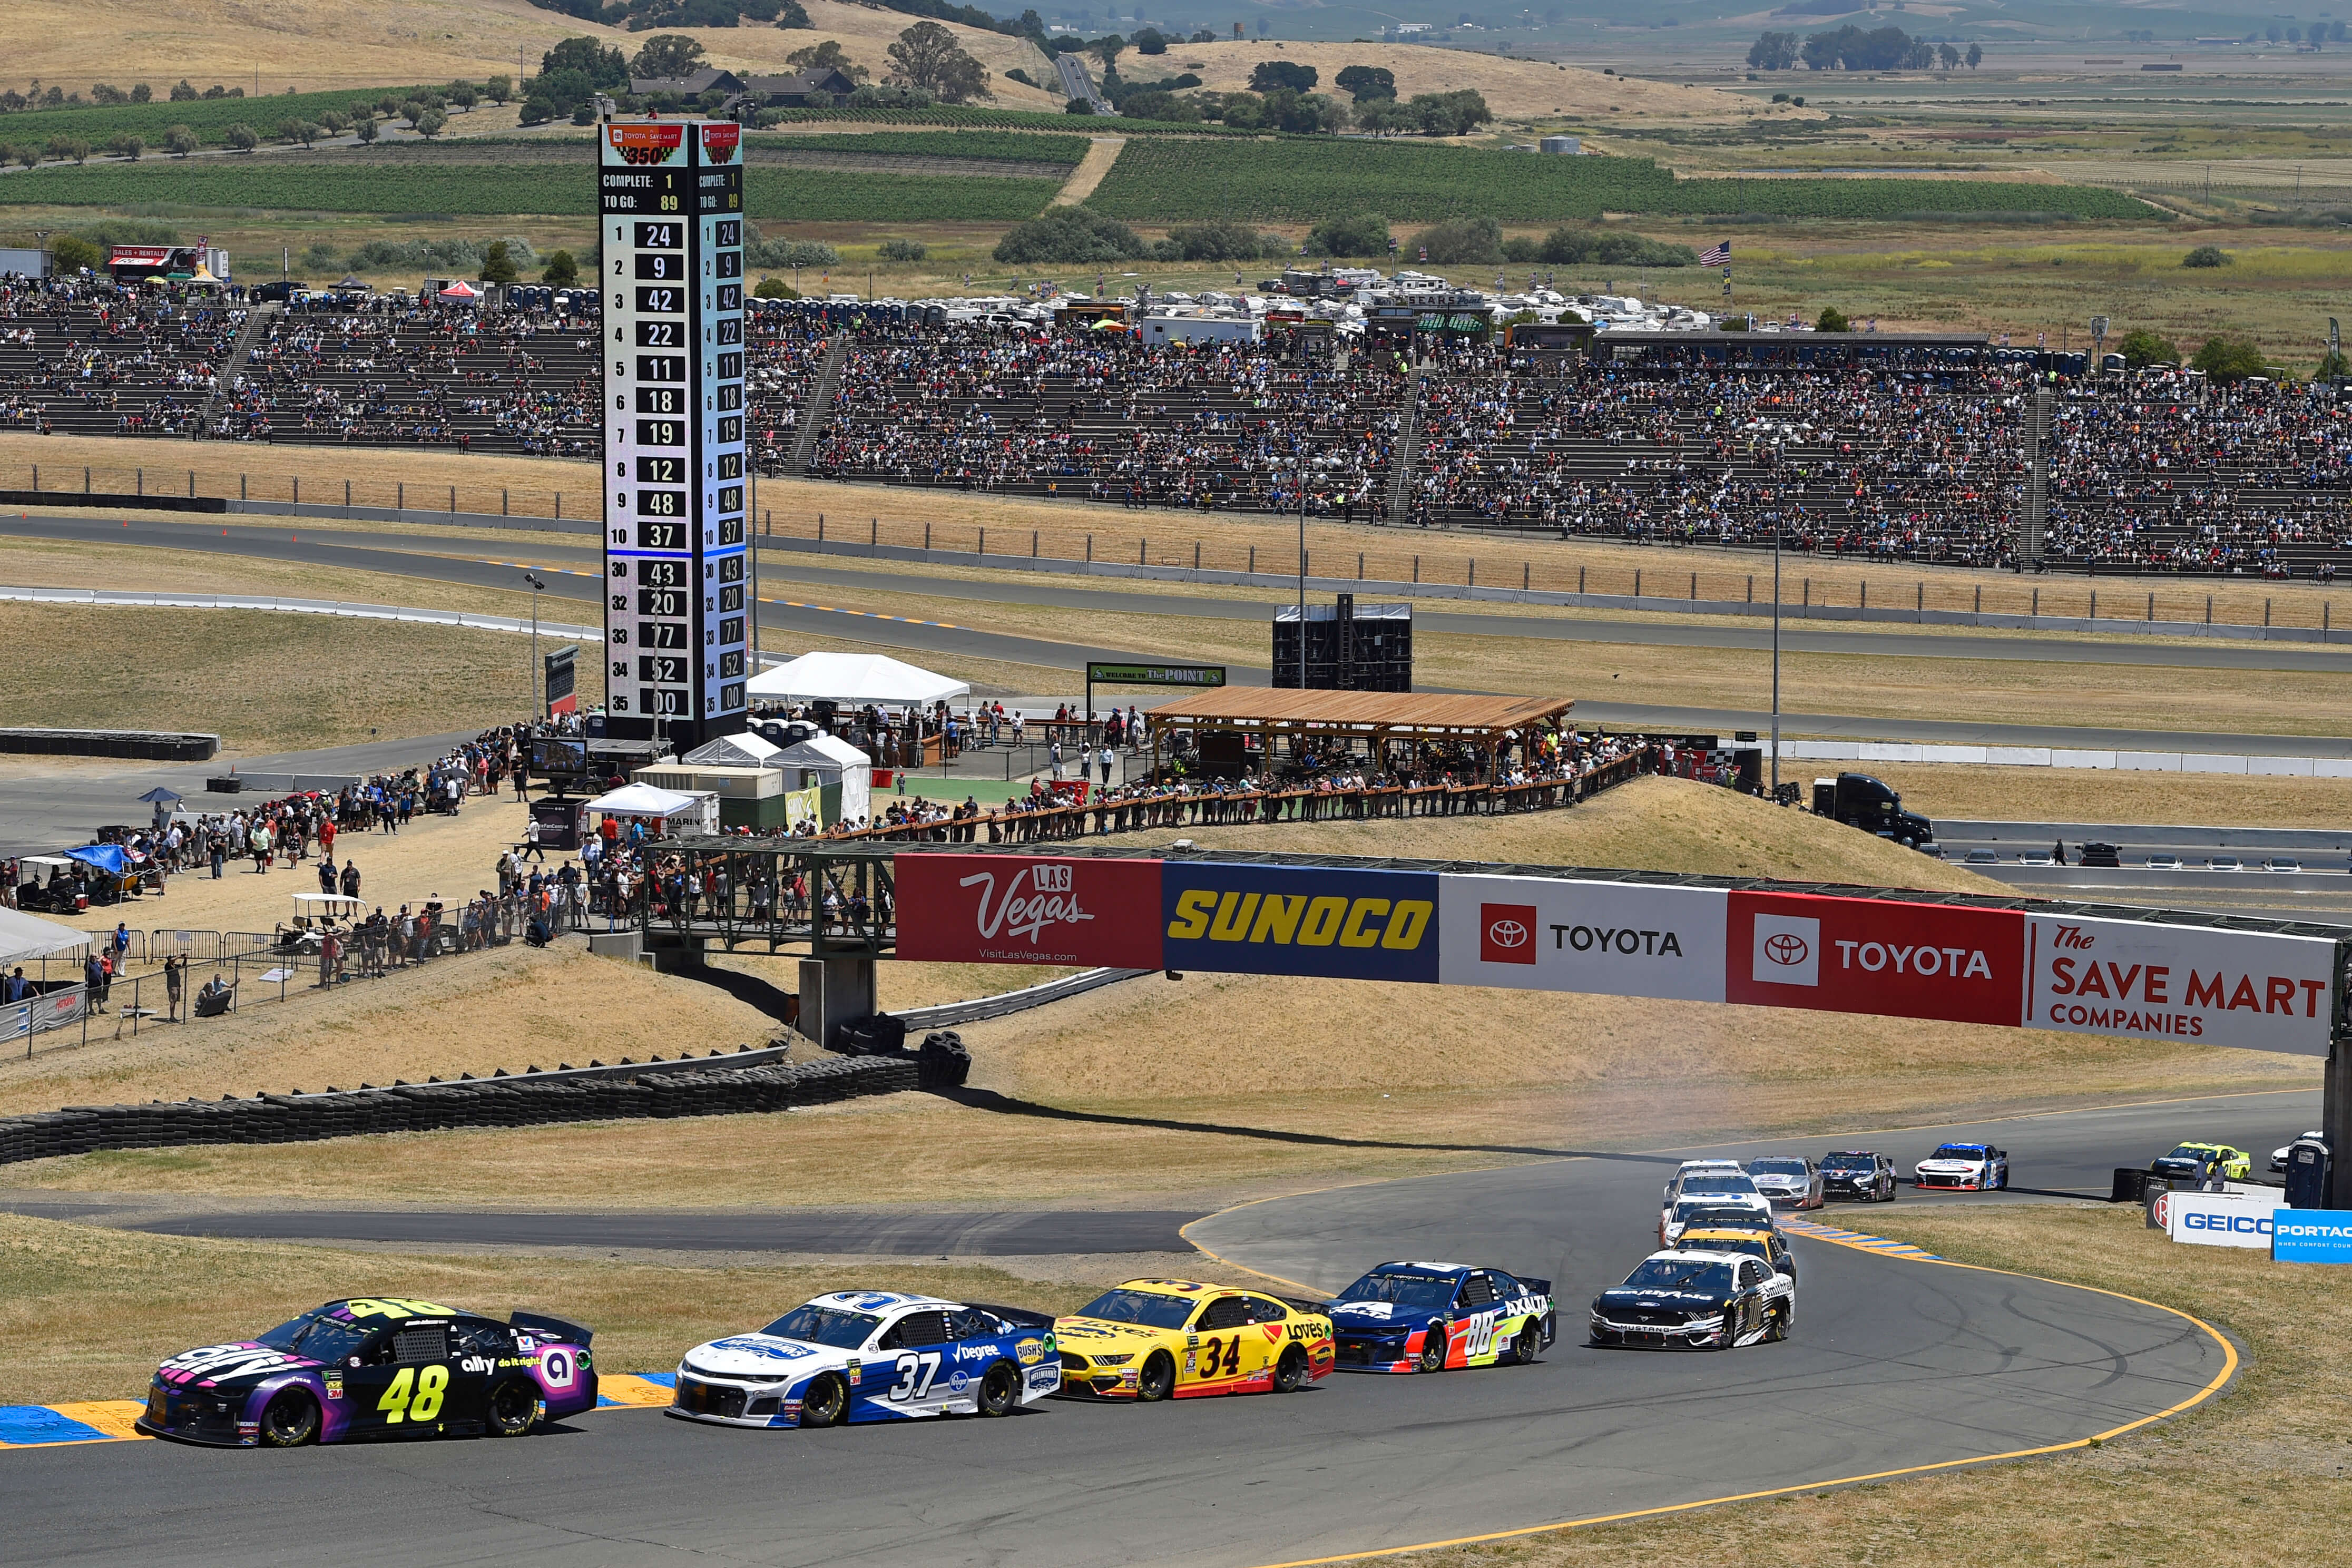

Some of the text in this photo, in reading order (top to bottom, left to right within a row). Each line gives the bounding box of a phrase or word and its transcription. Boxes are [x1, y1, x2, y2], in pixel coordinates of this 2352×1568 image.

[626, 146, 663, 165] 350
[711, 146, 729, 165] 350
[603, 174, 672, 189] COMPLETE: 1
[699, 173, 735, 188] COMPLETE: 1
[604, 195, 678, 211] TO GO: 89
[700, 193, 738, 208] TO GO: 89
[615, 226, 671, 247] 1 24
[705, 223, 734, 244] 1 24
[614, 257, 665, 279] 2 9
[705, 255, 732, 276] 2 9
[615, 290, 672, 311] 3 42
[705, 287, 736, 309] 3 42
[1457, 296, 1482, 305] Point
[614, 324, 672, 346] 4 22
[706, 321, 736, 343] 4 22
[615, 359, 671, 380] 5 11
[707, 356, 735, 377] 5 11
[616, 390, 672, 412] 6 18
[707, 387, 736, 411] 6 18
[617, 423, 673, 444] 7 19
[708, 419, 737, 444] 7 19
[617, 460, 673, 482] 8 12
[708, 456, 737, 478] 8 12
[618, 493, 674, 514] 9 48
[708, 489, 737, 511] 9 48
[611, 525, 673, 546] 10 37
[705, 521, 737, 545] 10 37
[612, 562, 674, 585] 30 43
[705, 558, 738, 580] 30 43
[612, 593, 675, 614] 32 20
[705, 589, 738, 612] 32 20
[612, 626, 674, 647] 33 77
[706, 621, 738, 645] 33 77
[612, 660, 675, 681] 34 52
[707, 654, 739, 679] 34 52
[1146, 669, 1165, 679] The
[1164, 669, 1206, 682] POINT
[612, 692, 676, 713] 35 00
[707, 687, 739, 712] 35 00
[667, 817, 700, 826] MARIN
[1036, 866, 1069, 889] LAS
[959, 868, 1095, 945] Vegas
[1167, 889, 1434, 950] SUNOCO
[1550, 924, 1683, 957] TOYOTA
[2054, 924, 2095, 949] The
[978, 948, 1077, 962] VisitLasVegas.com
[1835, 939, 1993, 979] TOYOTA
[2052, 957, 2326, 1018] SAVE MART
[2050, 1003, 2203, 1036] COMPANIES
[1504, 1295, 1549, 1317] AXALTA
[1746, 1294, 1762, 1332] 10
[1464, 1311, 1495, 1357] 88
[961, 1344, 1001, 1361] Degree
[1017, 1343, 1043, 1358] BUSH'S
[1199, 1334, 1241, 1379] 34
[461, 1356, 495, 1376] ally
[498, 1358, 511, 1367] do
[511, 1357, 520, 1366] it
[277, 1376, 311, 1387] GOODYEAR
[850, 1376, 861, 1385] 3M
[888, 1350, 943, 1402] 37
[950, 1374, 967, 1390] Kroger
[329, 1390, 343, 1398] 3M
[376, 1365, 449, 1424] 48
